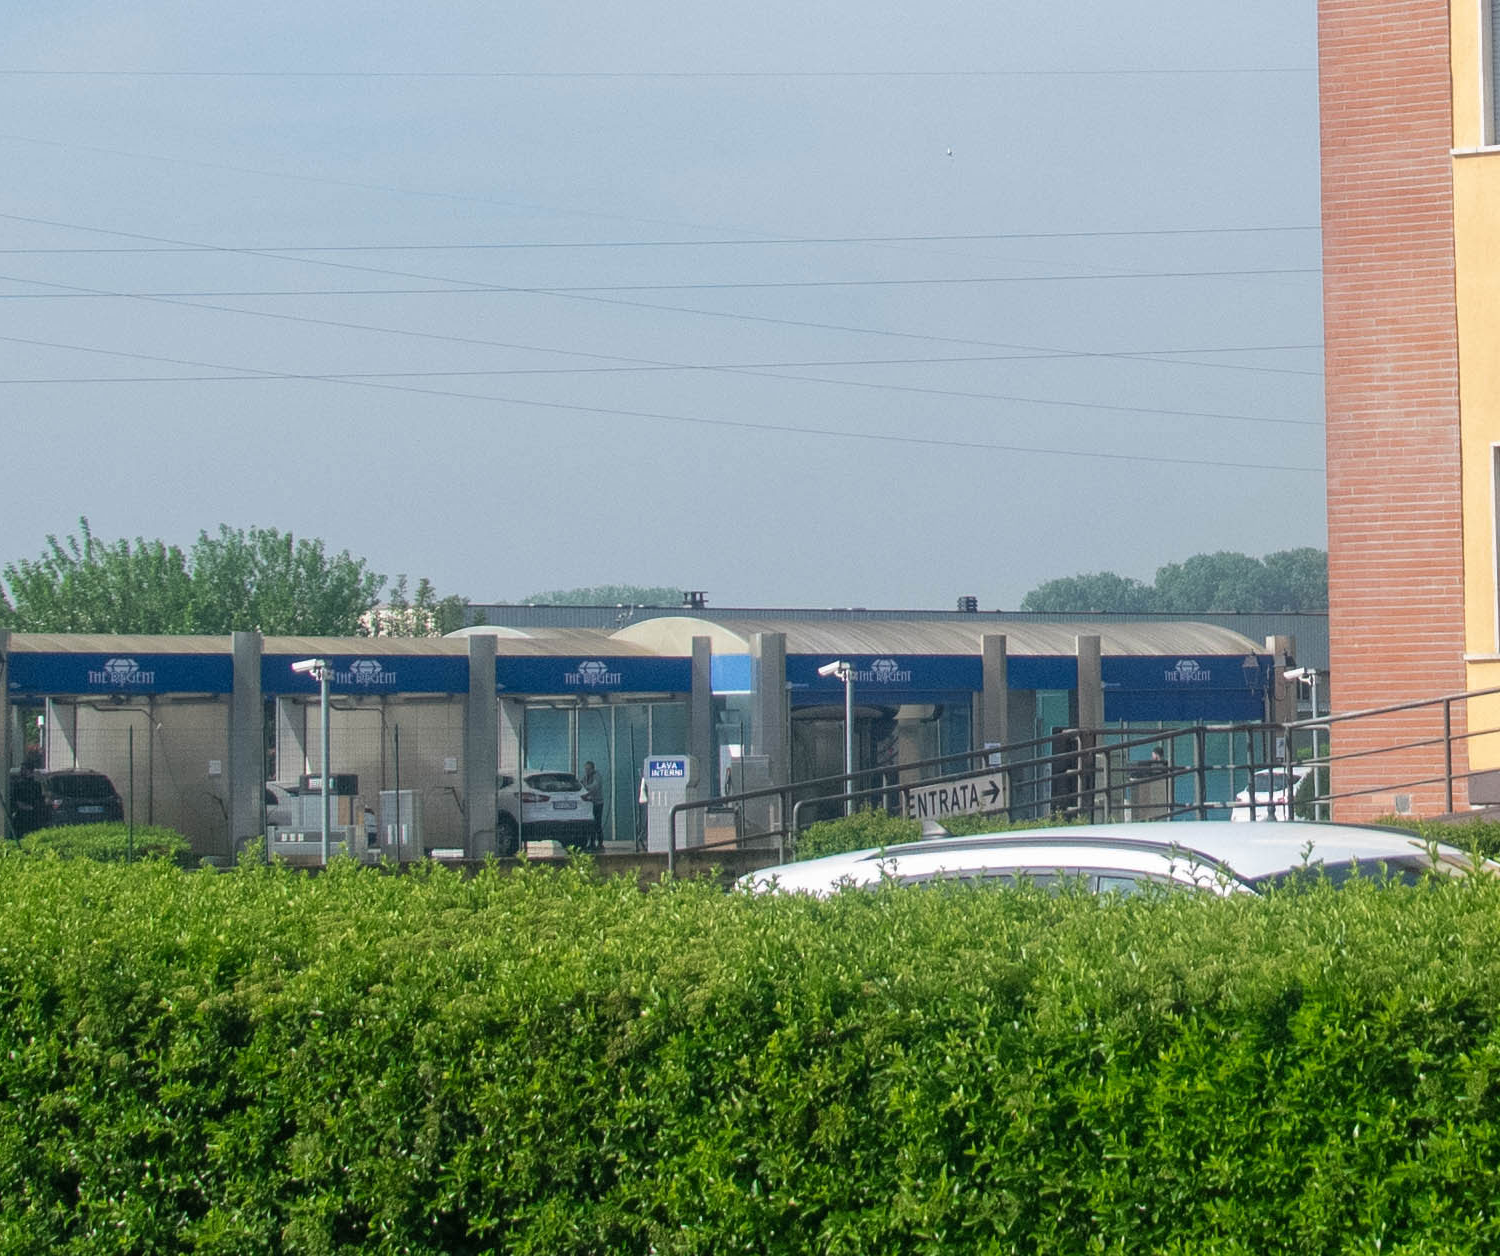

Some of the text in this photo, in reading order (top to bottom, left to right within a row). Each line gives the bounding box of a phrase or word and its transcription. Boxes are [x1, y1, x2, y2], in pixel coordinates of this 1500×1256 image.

[88, 671, 108, 683] THE
[656, 762, 677, 770] LAVA
[908, 783, 980, 819] ENTRATA
